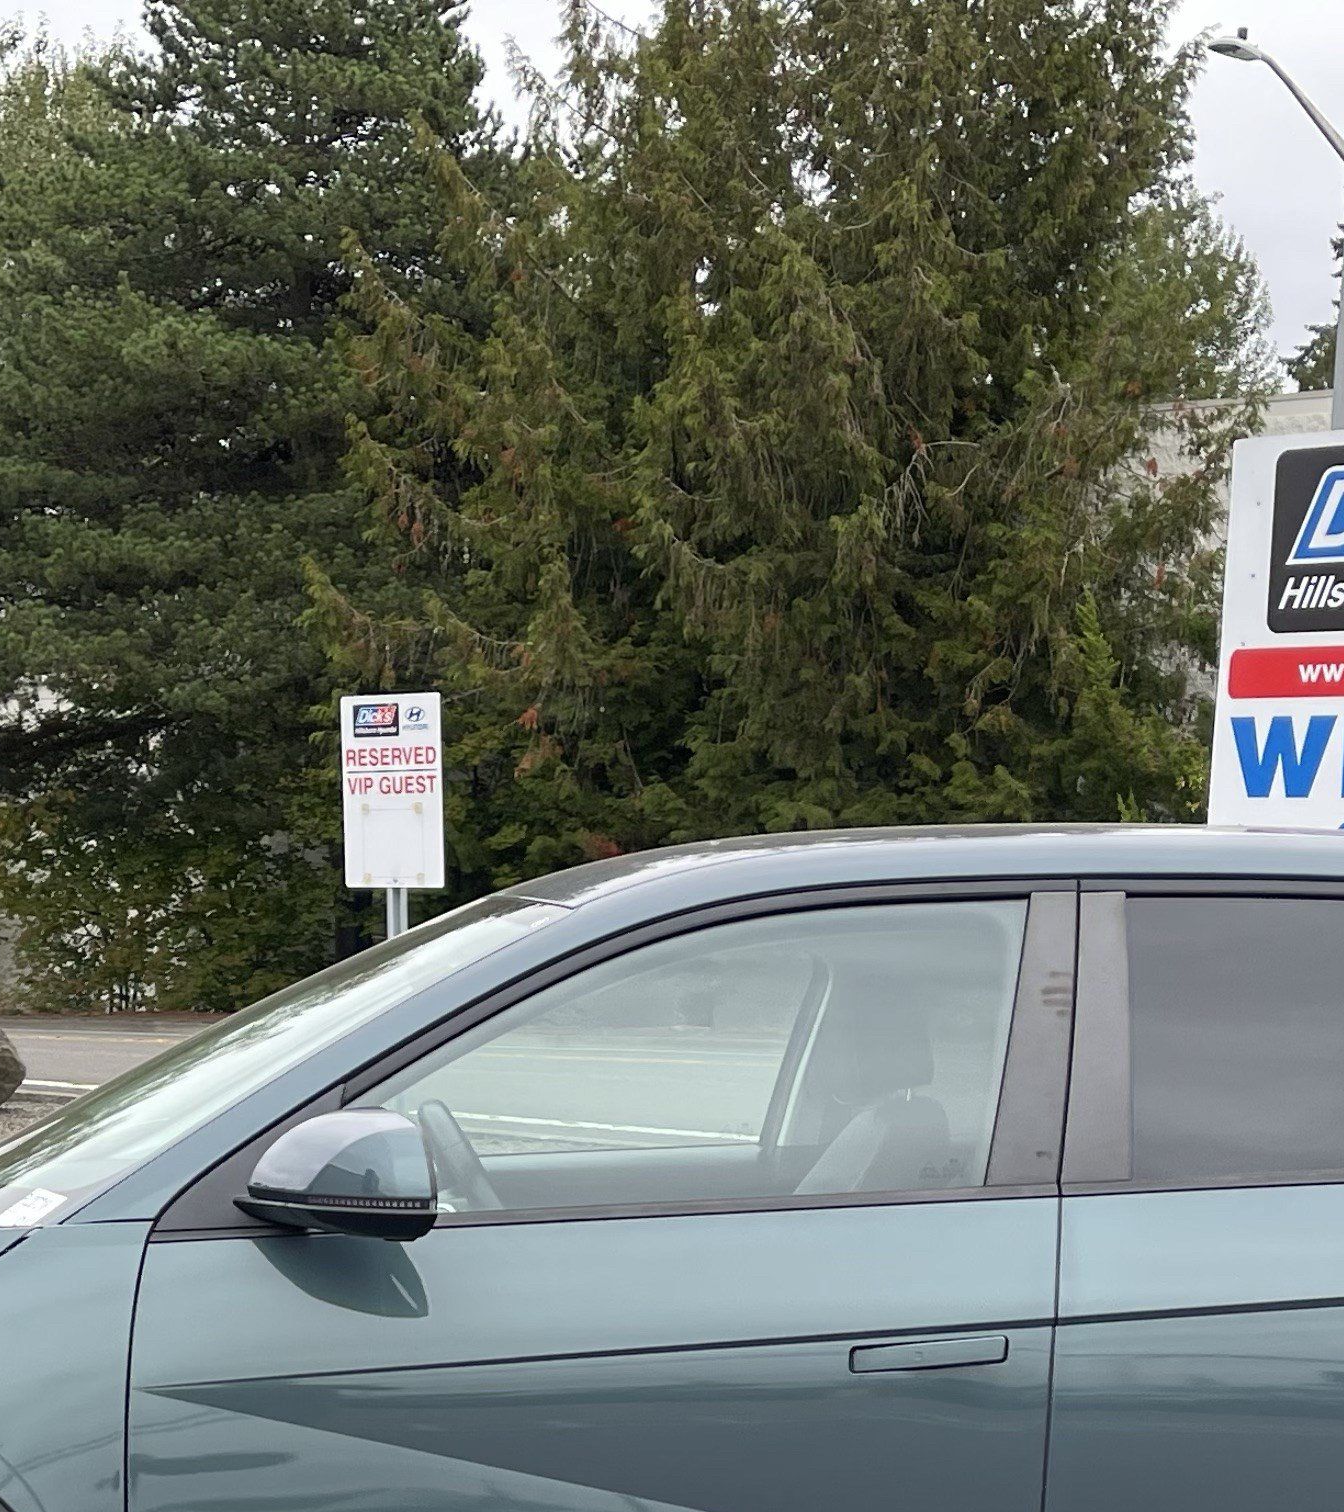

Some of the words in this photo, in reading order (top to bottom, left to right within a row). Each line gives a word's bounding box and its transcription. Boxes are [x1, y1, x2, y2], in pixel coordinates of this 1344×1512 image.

[346, 746, 436, 766] RESERVED
[348, 776, 373, 795] VIP
[379, 775, 436, 795] GUEST
